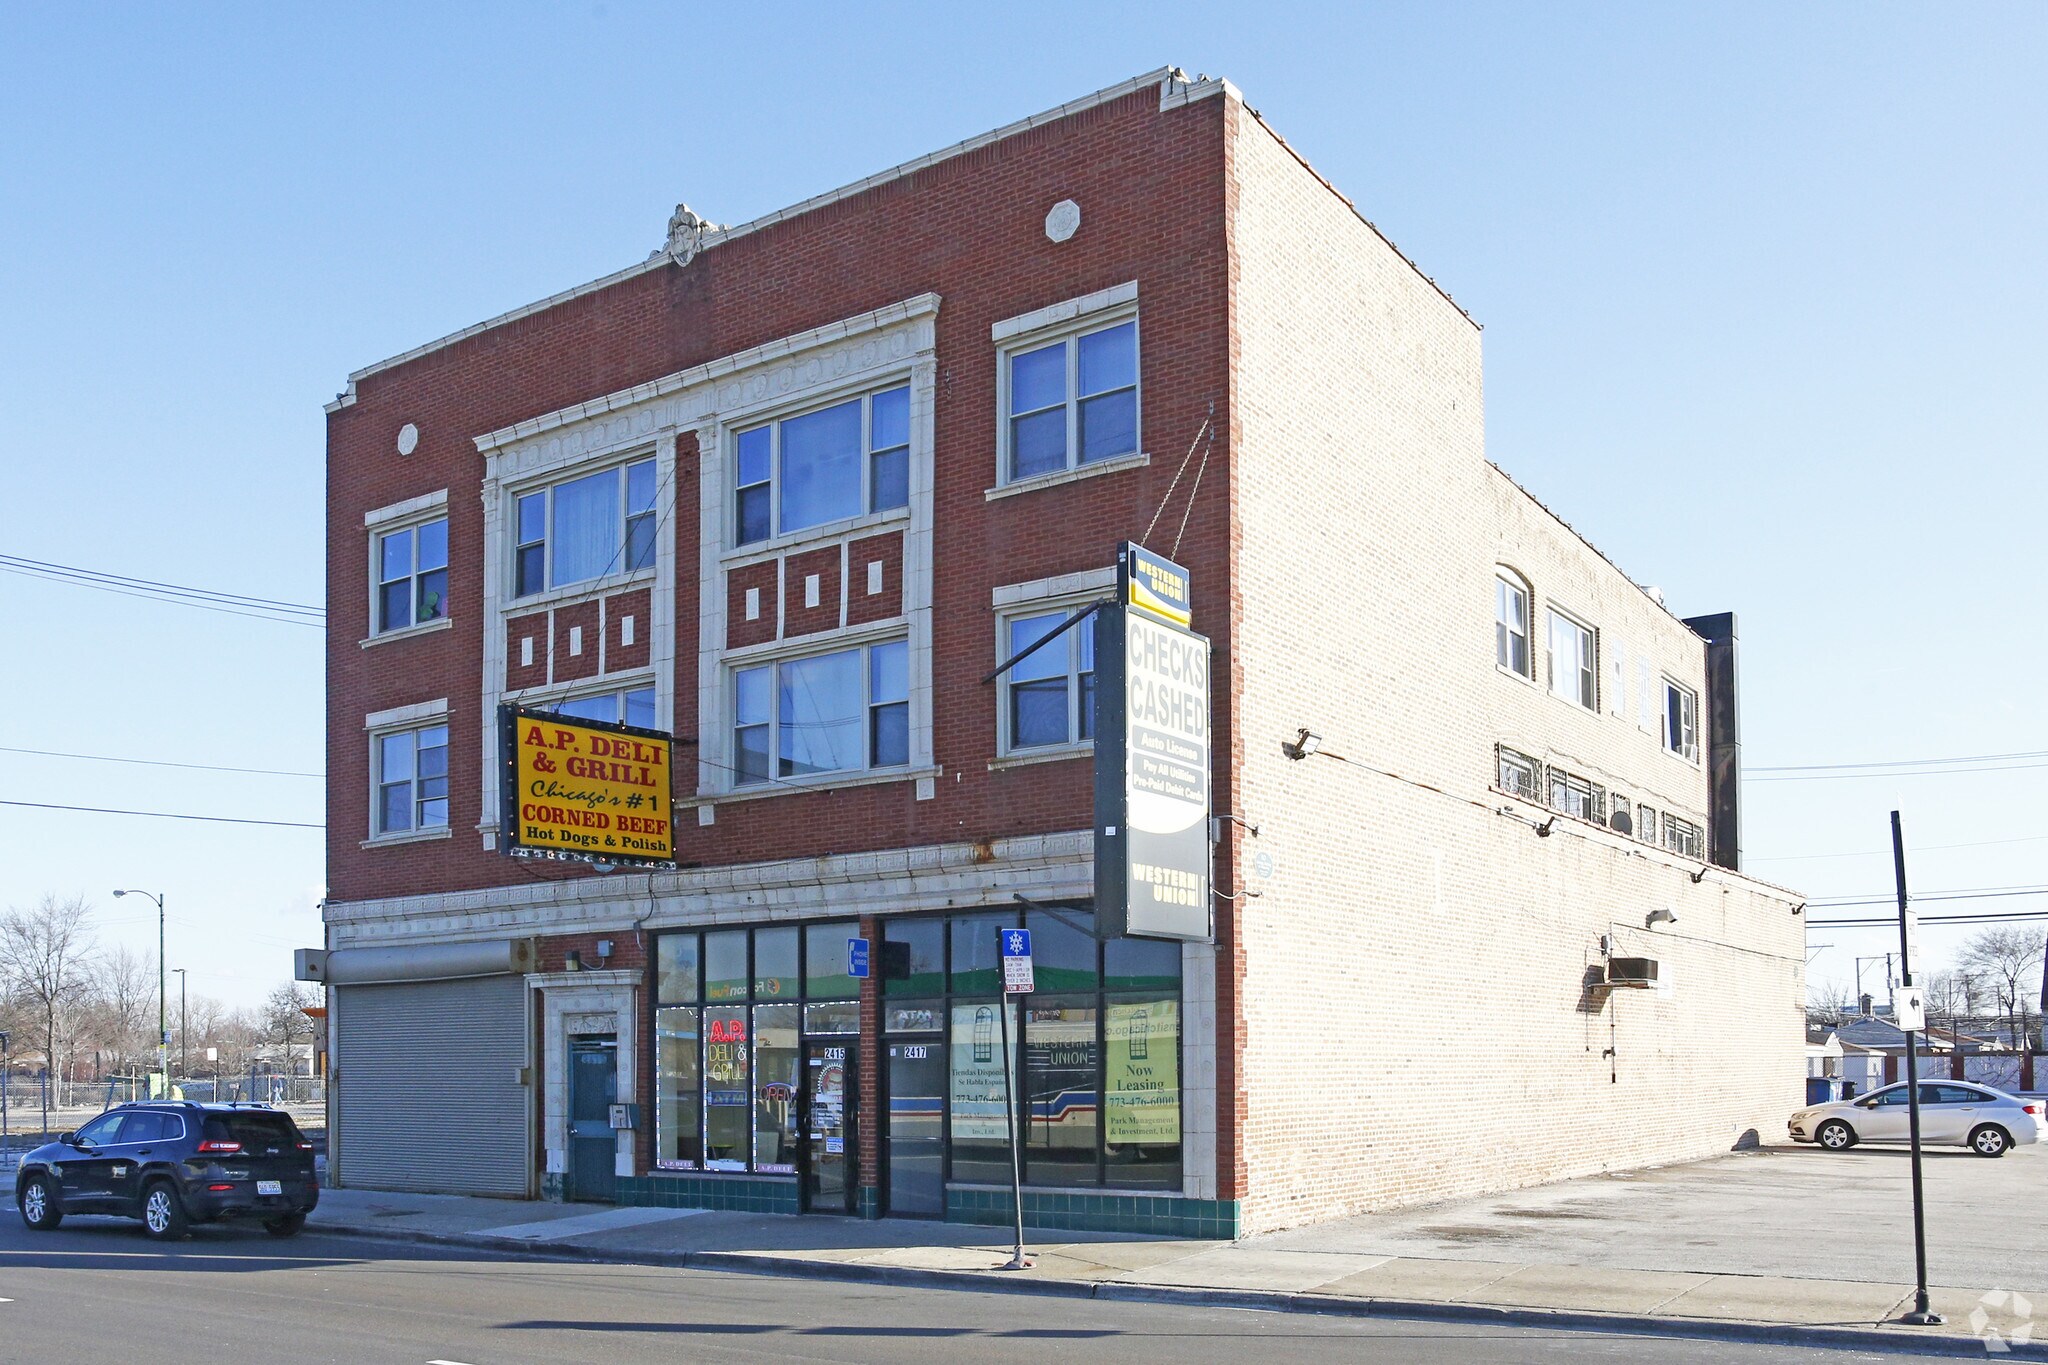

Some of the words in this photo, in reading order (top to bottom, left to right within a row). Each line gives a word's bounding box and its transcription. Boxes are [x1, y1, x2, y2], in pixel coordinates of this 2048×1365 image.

[1138, 559, 1182, 590] WESTERN
[1151, 579, 1182, 602] UNION
[1130, 623, 1204, 690] CHECKS
[1131, 675, 1204, 738] CASHED
[525, 726, 580, 752] A.P.
[590, 736, 662, 765] DELI
[1141, 732, 1165, 751] Auto
[1166, 738, 1198, 761] License
[533, 752, 556, 774] &
[566, 757, 656, 787] GRILL
[1143, 758, 1158, 775] Pay
[1158, 763, 1169, 776] All
[531, 781, 621, 808] Chicago's
[523, 804, 609, 829] CORNED
[617, 815, 667, 835] BEEF
[526, 826, 554, 840] Hot
[560, 830, 599, 846] Dogs
[604, 835, 616, 846] &
[622, 837, 667, 851] Polish
[1132, 862, 1198, 890] WESTERN
[1153, 884, 1198, 907] UNION
[899, 1010, 932, 1020] ATM
[710, 1019, 747, 1042] A.P.
[709, 1044, 733, 1062] DELI
[825, 1048, 845, 1059] 2415
[905, 1047, 926, 1058] 2417
[1051, 1052, 1088, 1065] UNION
[1126, 1065, 1153, 1076] Now
[761, 1086, 792, 1102] OPEN
[1117, 1079, 1164, 1093] Leasing
[1109, 1096, 1174, 1107] 773-476-6000
[1129, 1117, 1174, 1125] Management
